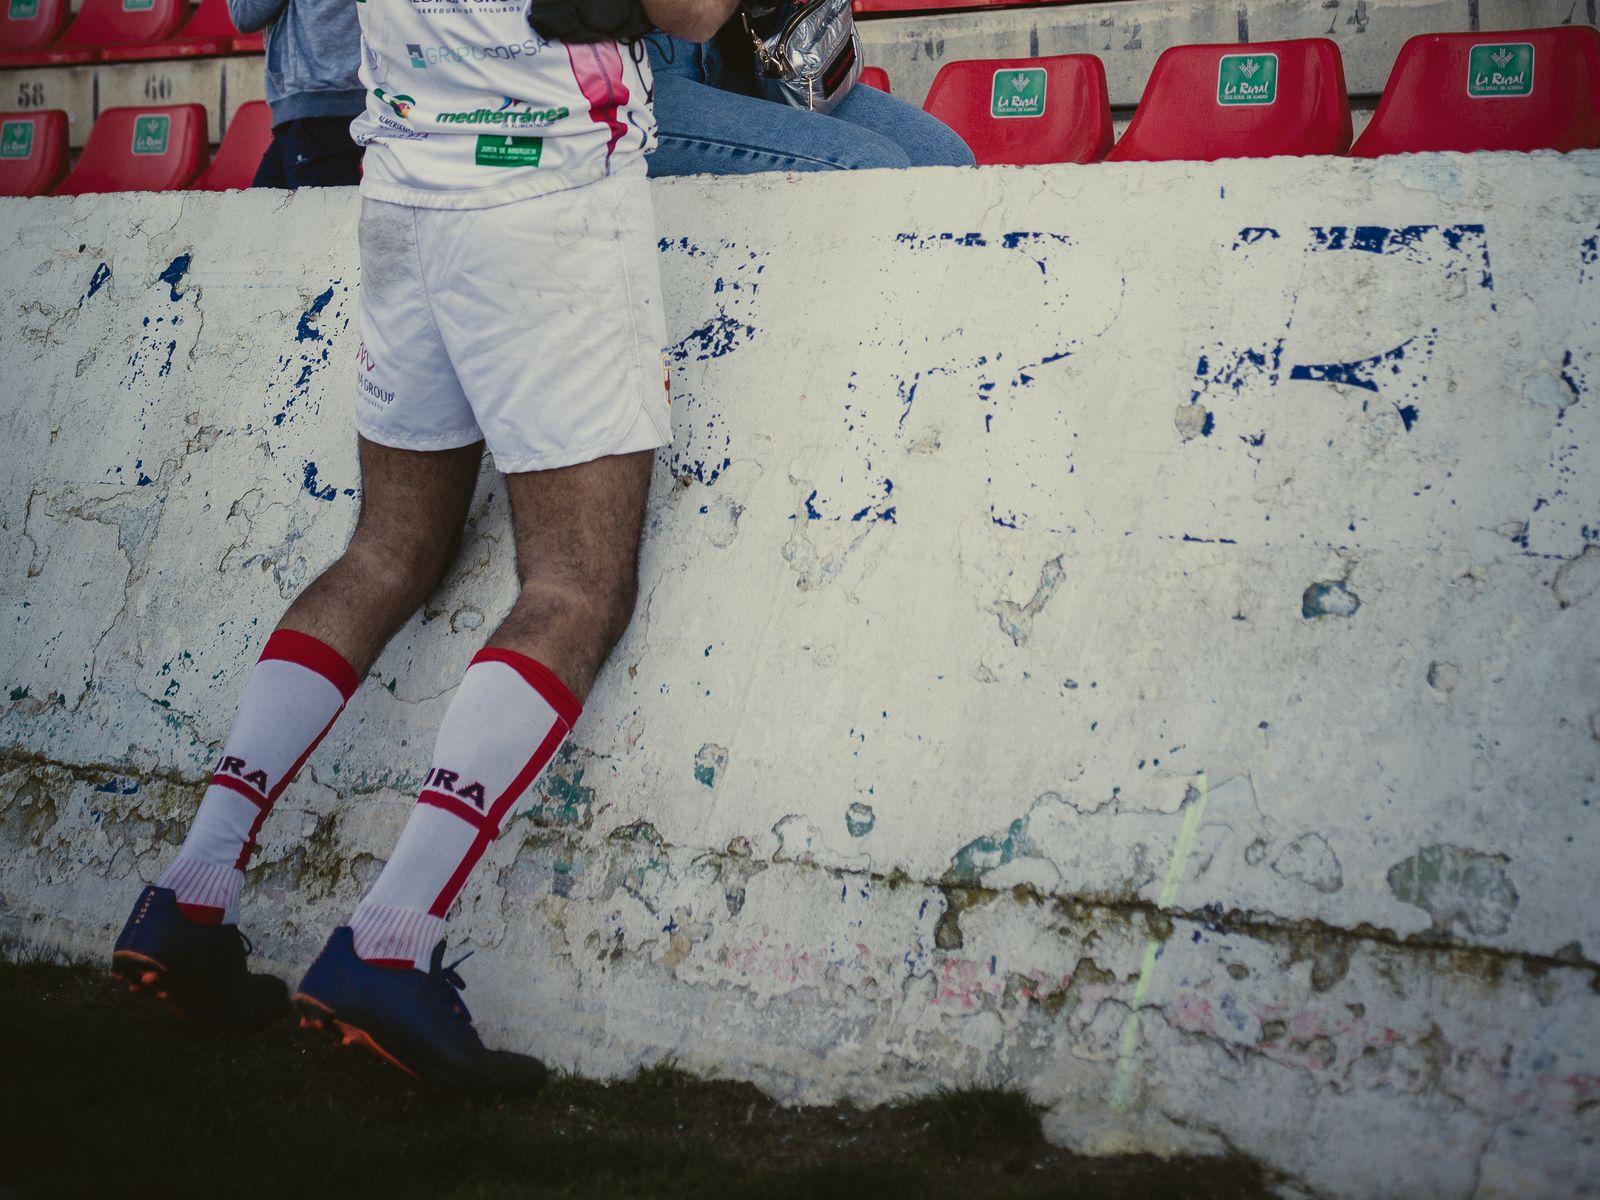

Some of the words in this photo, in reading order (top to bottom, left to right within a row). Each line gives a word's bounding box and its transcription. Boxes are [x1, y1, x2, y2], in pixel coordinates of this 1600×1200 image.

[1476, 73, 1488, 86] La
[1492, 72, 1524, 85] Rural
[1225, 81, 1237, 95] La
[1240, 81, 1269, 95] Rural
[998, 96, 1009, 107] La
[1012, 94, 1038, 107] Rural
[436, 106, 569, 124] mediterránea
